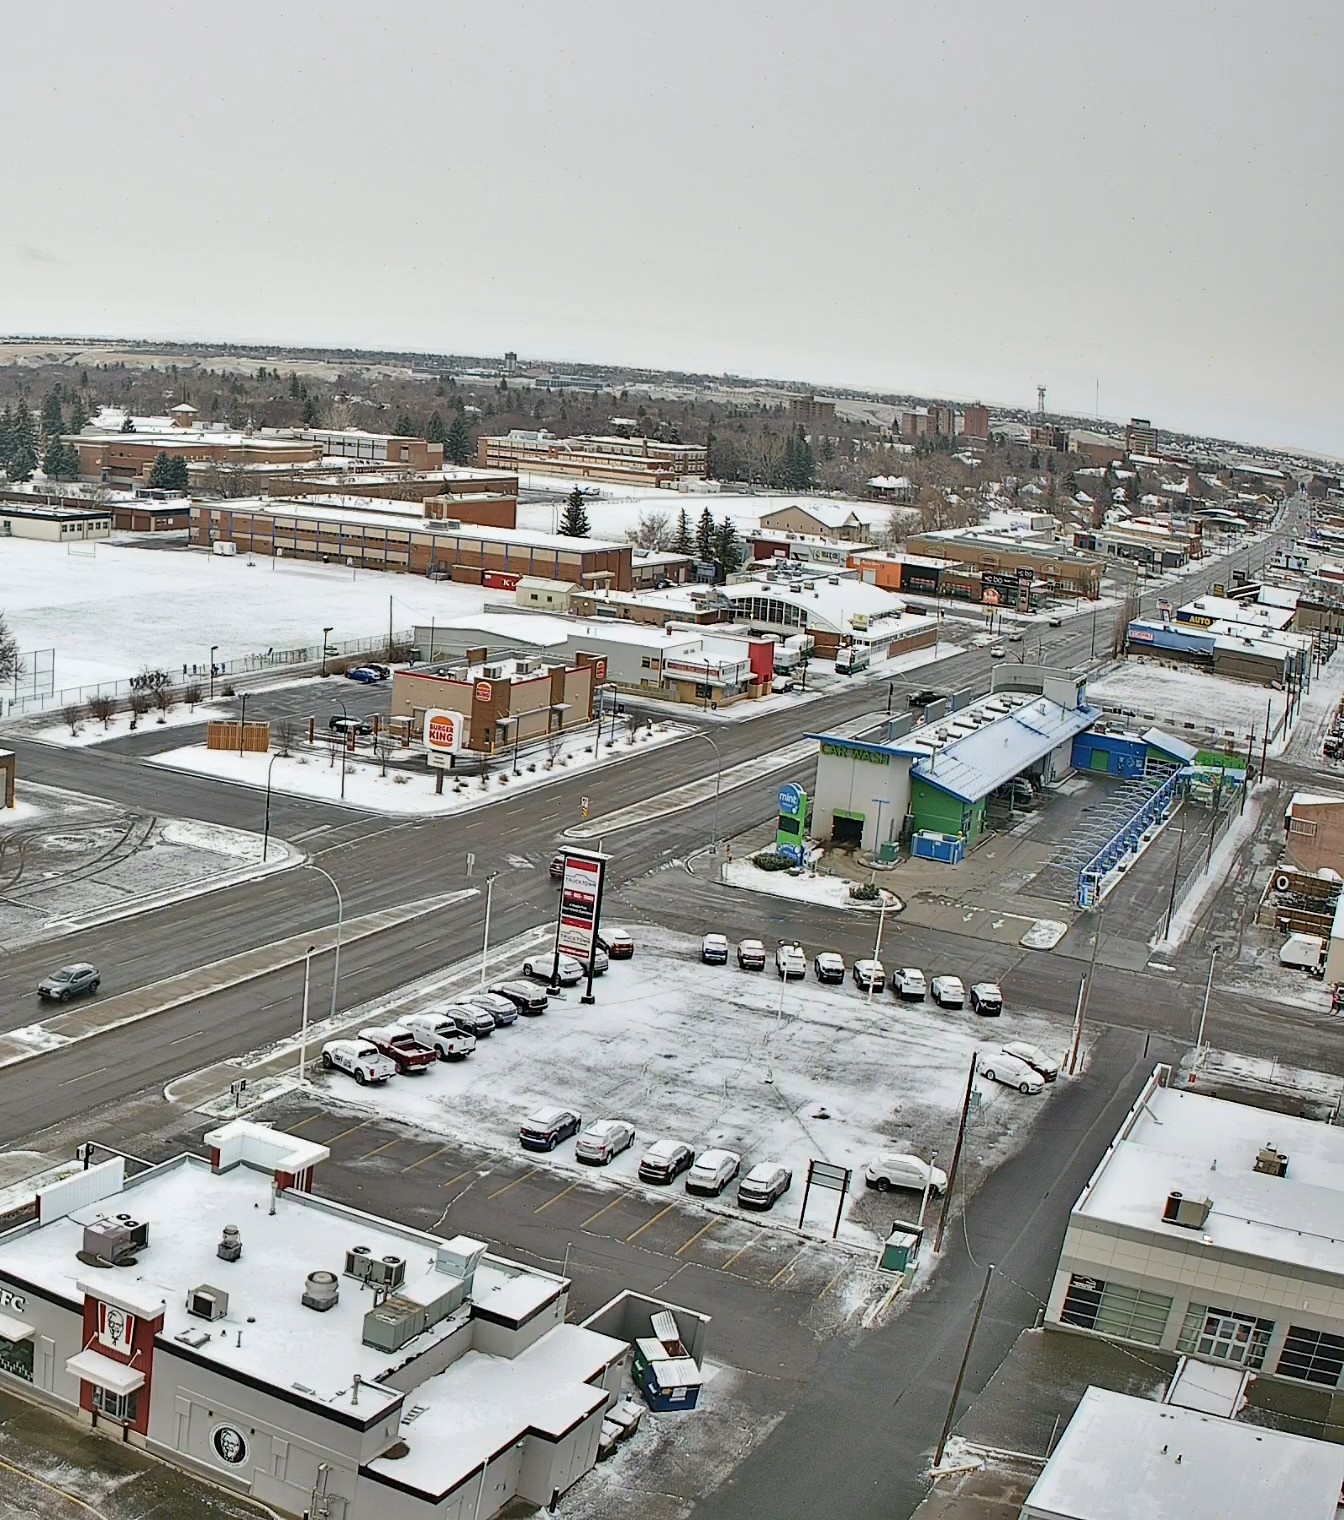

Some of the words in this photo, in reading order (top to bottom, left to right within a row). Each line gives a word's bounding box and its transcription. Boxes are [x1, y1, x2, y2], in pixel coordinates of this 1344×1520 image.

[1189, 615, 1211, 626] AUTO
[429, 723, 454, 734] BURGER
[428, 731, 453, 742] KING
[821, 743, 847, 757] CAR
[852, 749, 890, 766] WASH
[779, 792, 797, 804] mint
